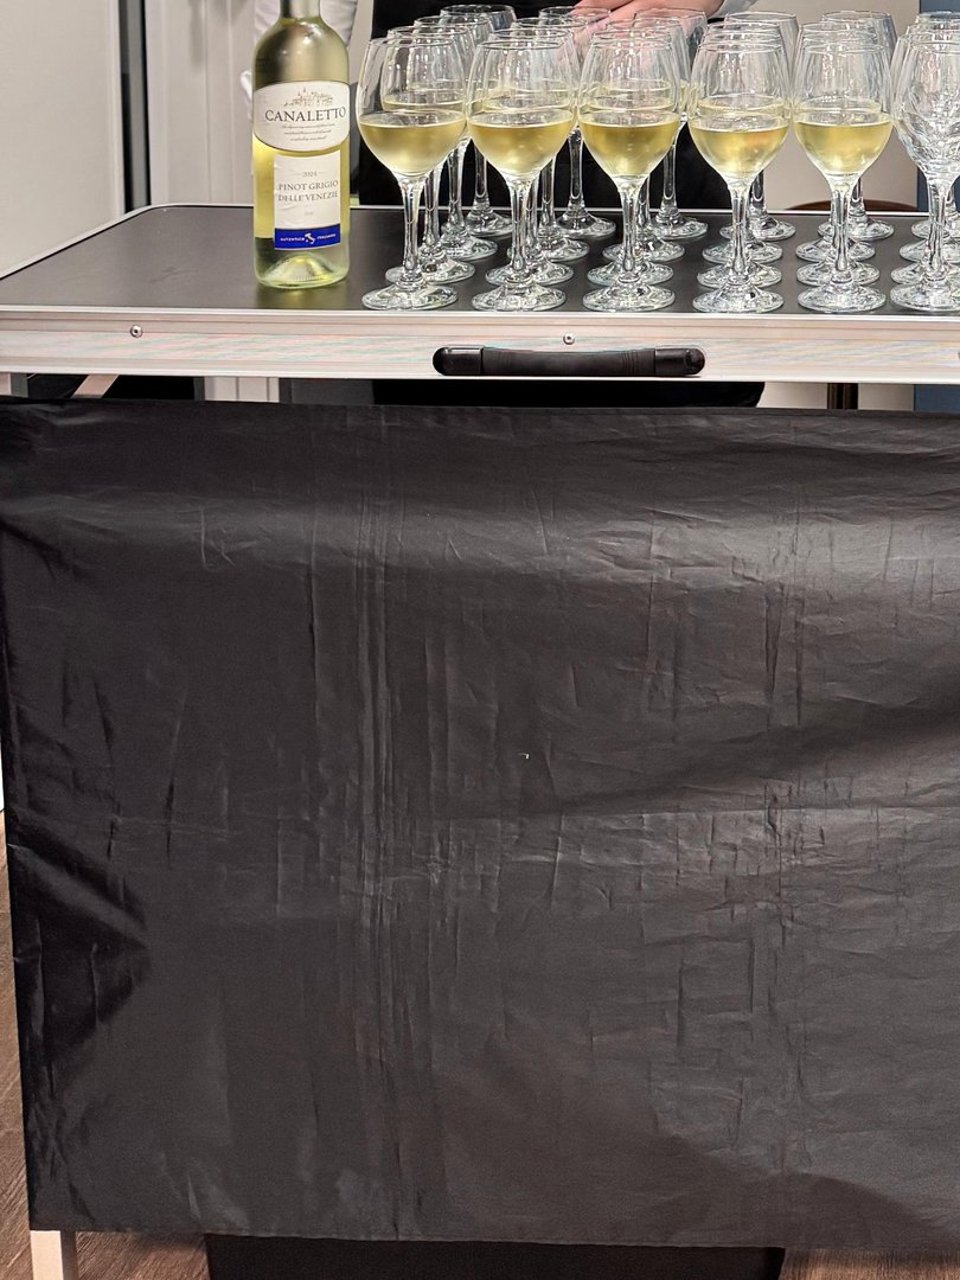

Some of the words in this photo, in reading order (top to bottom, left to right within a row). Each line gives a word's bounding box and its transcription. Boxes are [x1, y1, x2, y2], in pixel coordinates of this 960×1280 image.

[265, 106, 346, 122] CANALETTO
[278, 183, 308, 191] PINOT
[309, 179, 338, 190] GRIGIO
[305, 191, 338, 201] VENEZIE
